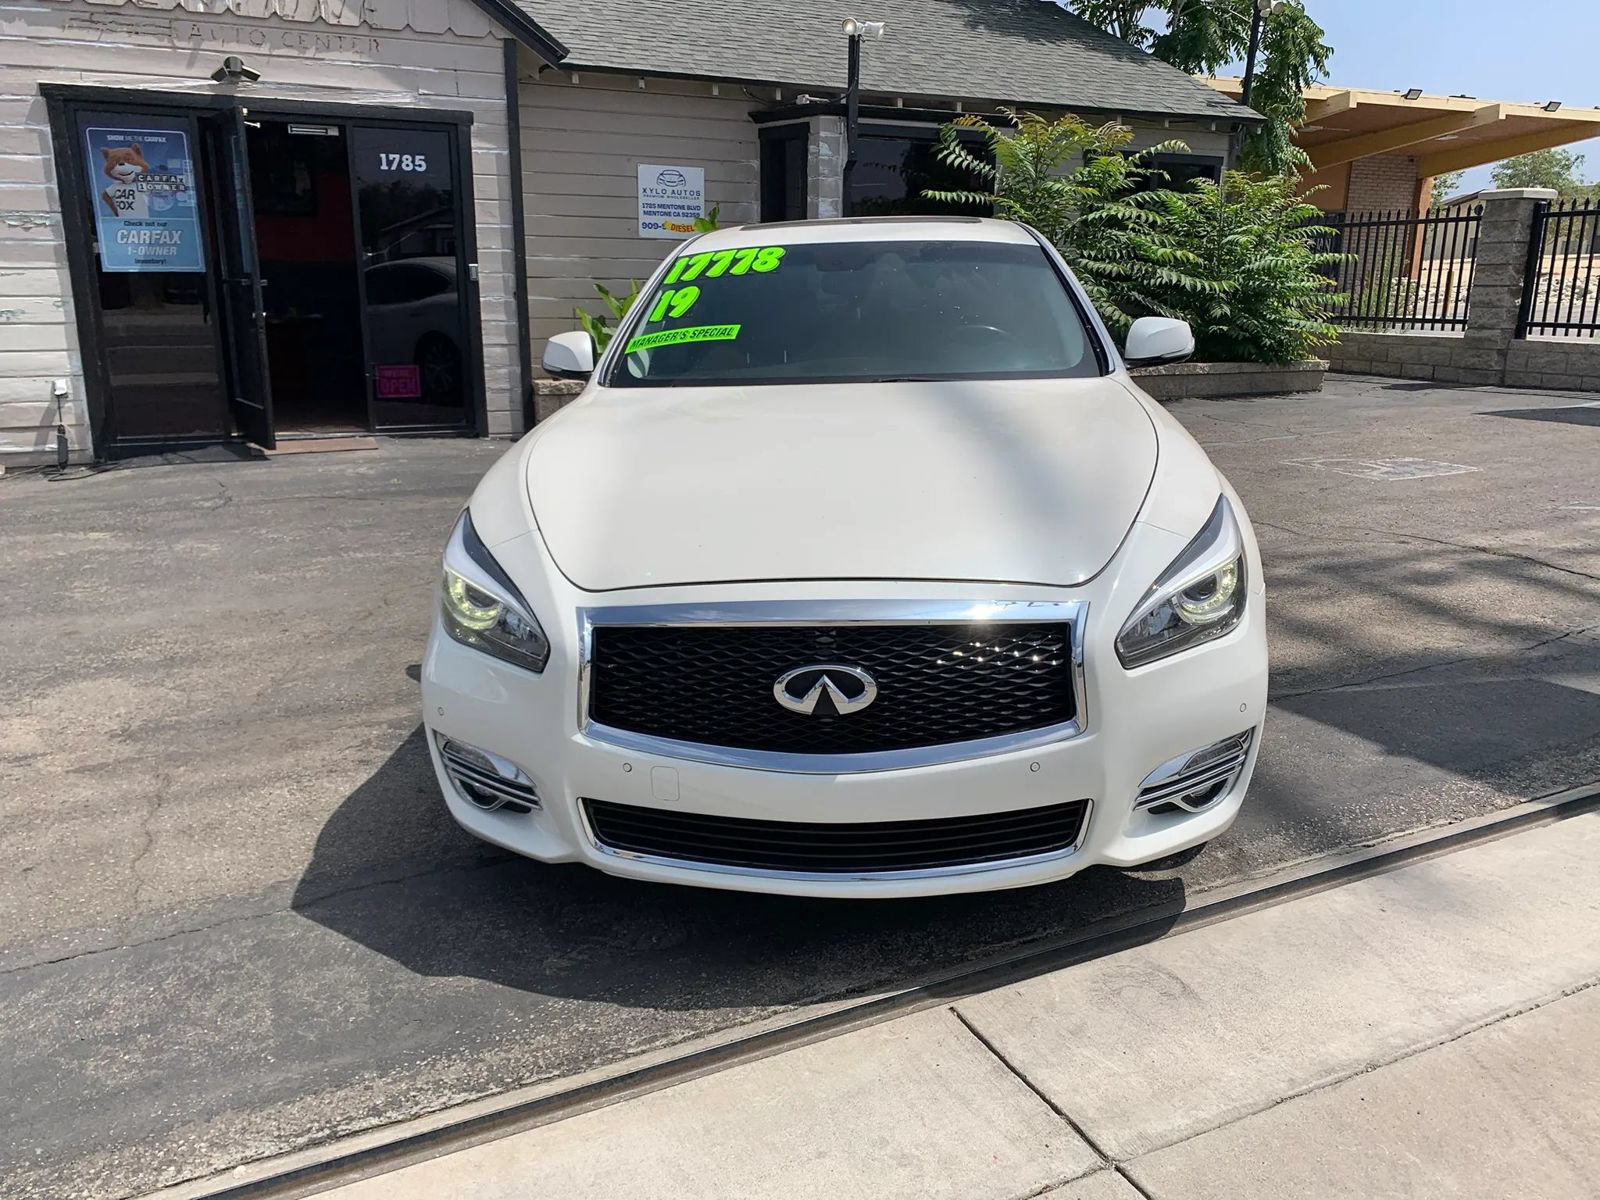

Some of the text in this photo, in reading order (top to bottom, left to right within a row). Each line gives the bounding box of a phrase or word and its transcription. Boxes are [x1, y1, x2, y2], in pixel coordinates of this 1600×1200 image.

[379, 153, 427, 172] 1785
[642, 187, 701, 197] XYLO AUTOS
[657, 203, 686, 211] MENTONE
[671, 223, 695, 233] DIESEL
[116, 229, 183, 244] CARFAX
[128, 246, 177, 256] 1-OWNER
[662, 246, 787, 285] 17778
[648, 285, 701, 323] 19
[631, 326, 735, 346] MANAGER'S SPECIAL
[380, 378, 417, 395] OPEN
